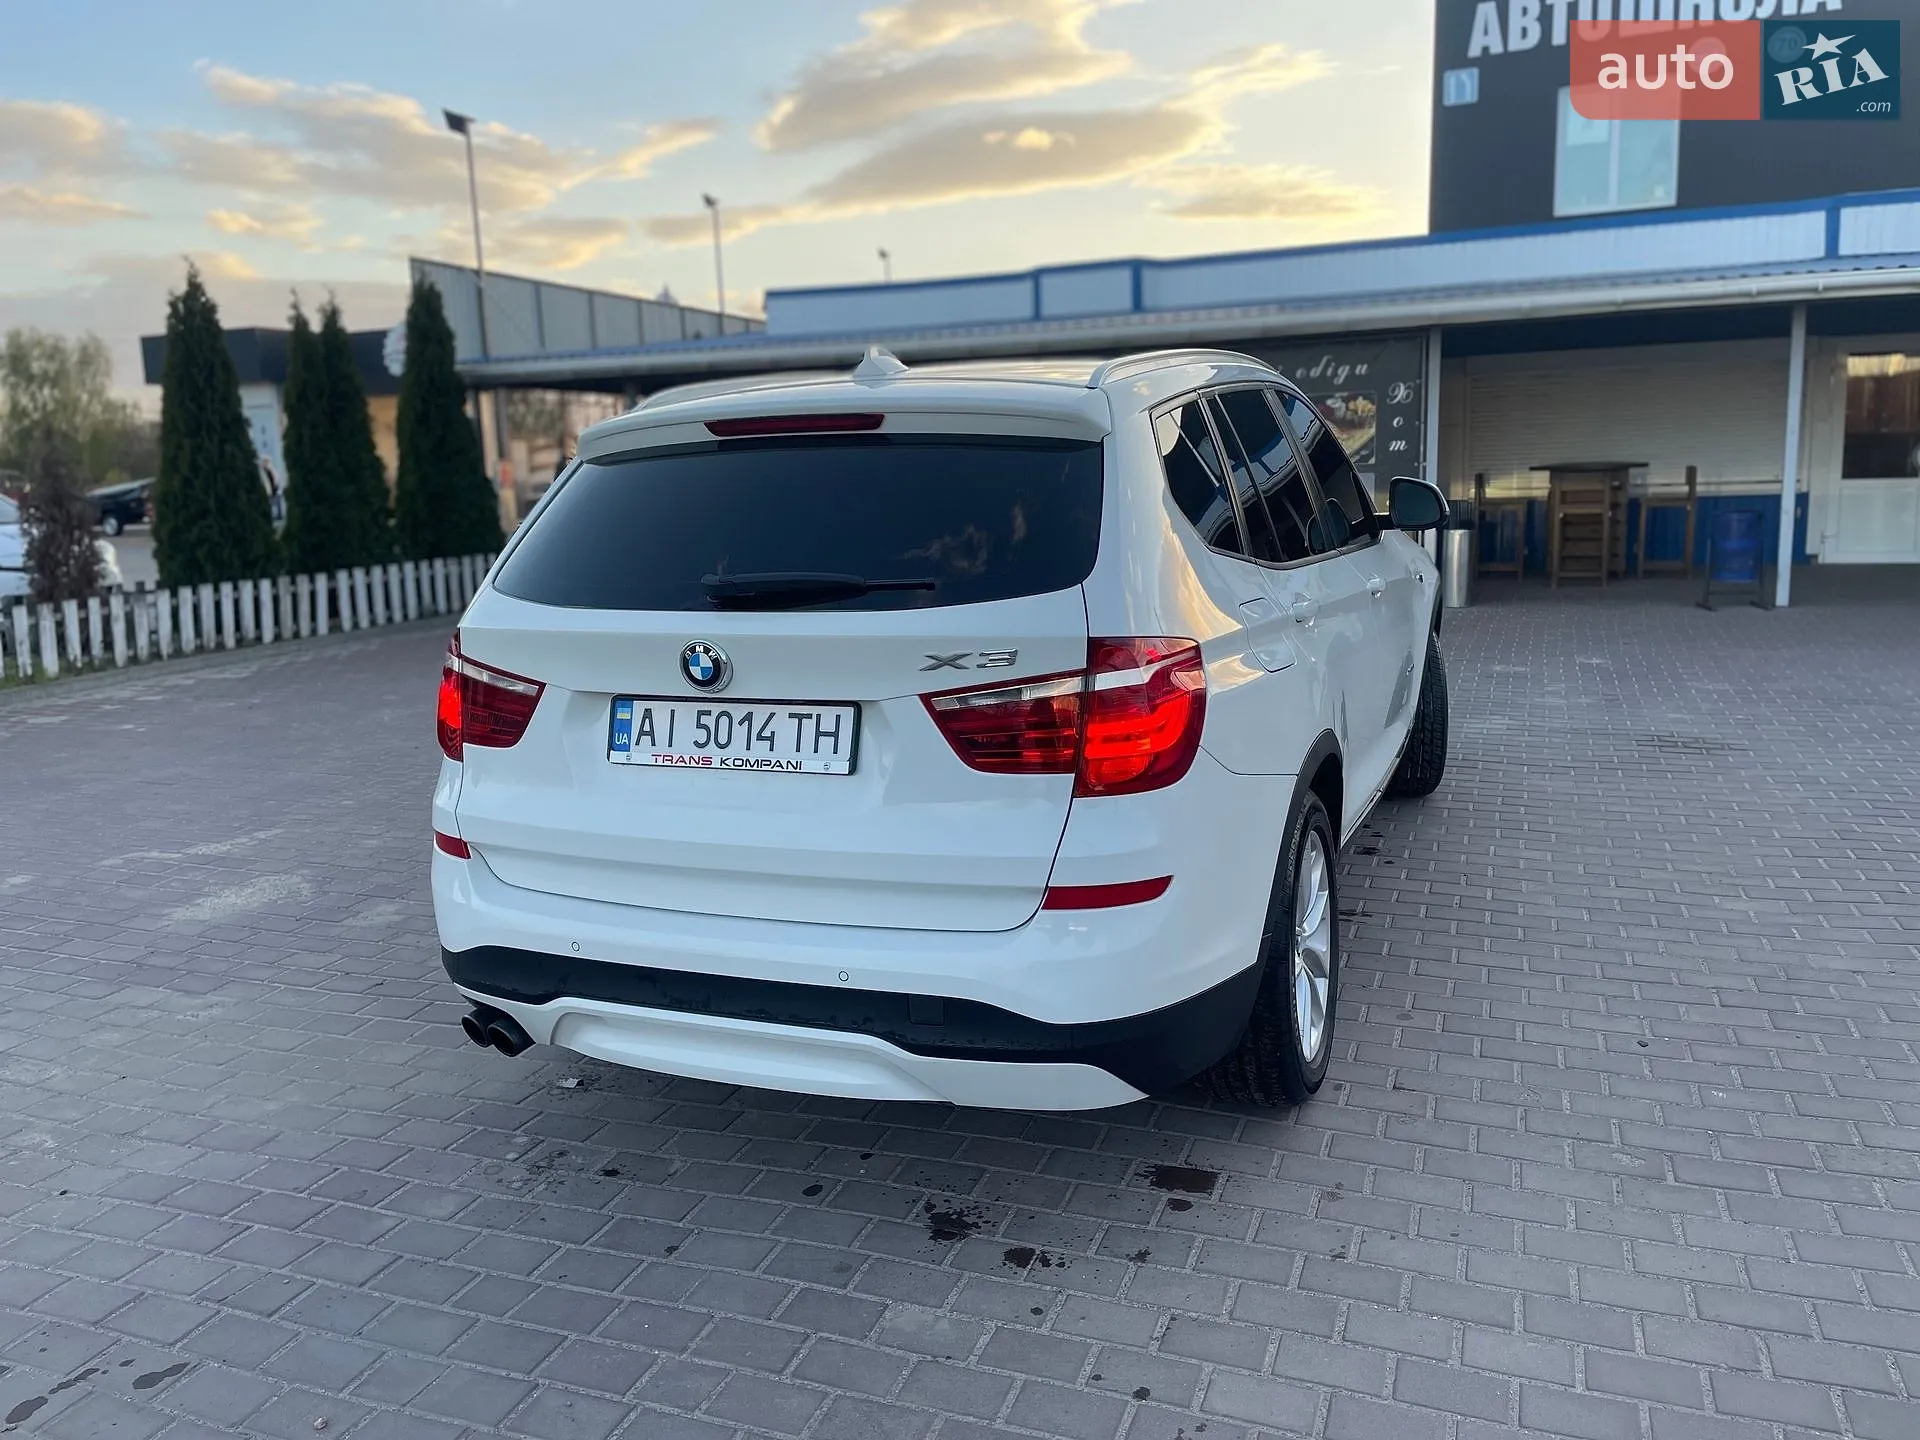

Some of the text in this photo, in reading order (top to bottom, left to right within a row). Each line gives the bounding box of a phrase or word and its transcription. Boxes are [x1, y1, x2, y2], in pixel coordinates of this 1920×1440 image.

[1467, 0, 1844, 58] АВТОШК
[685, 645, 718, 660] BMW
[919, 648, 1018, 671] X3
[614, 732, 629, 745] UA
[635, 707, 841, 755] AI 5014 TH
[651, 753, 803, 771] TRANS KOMPANI
